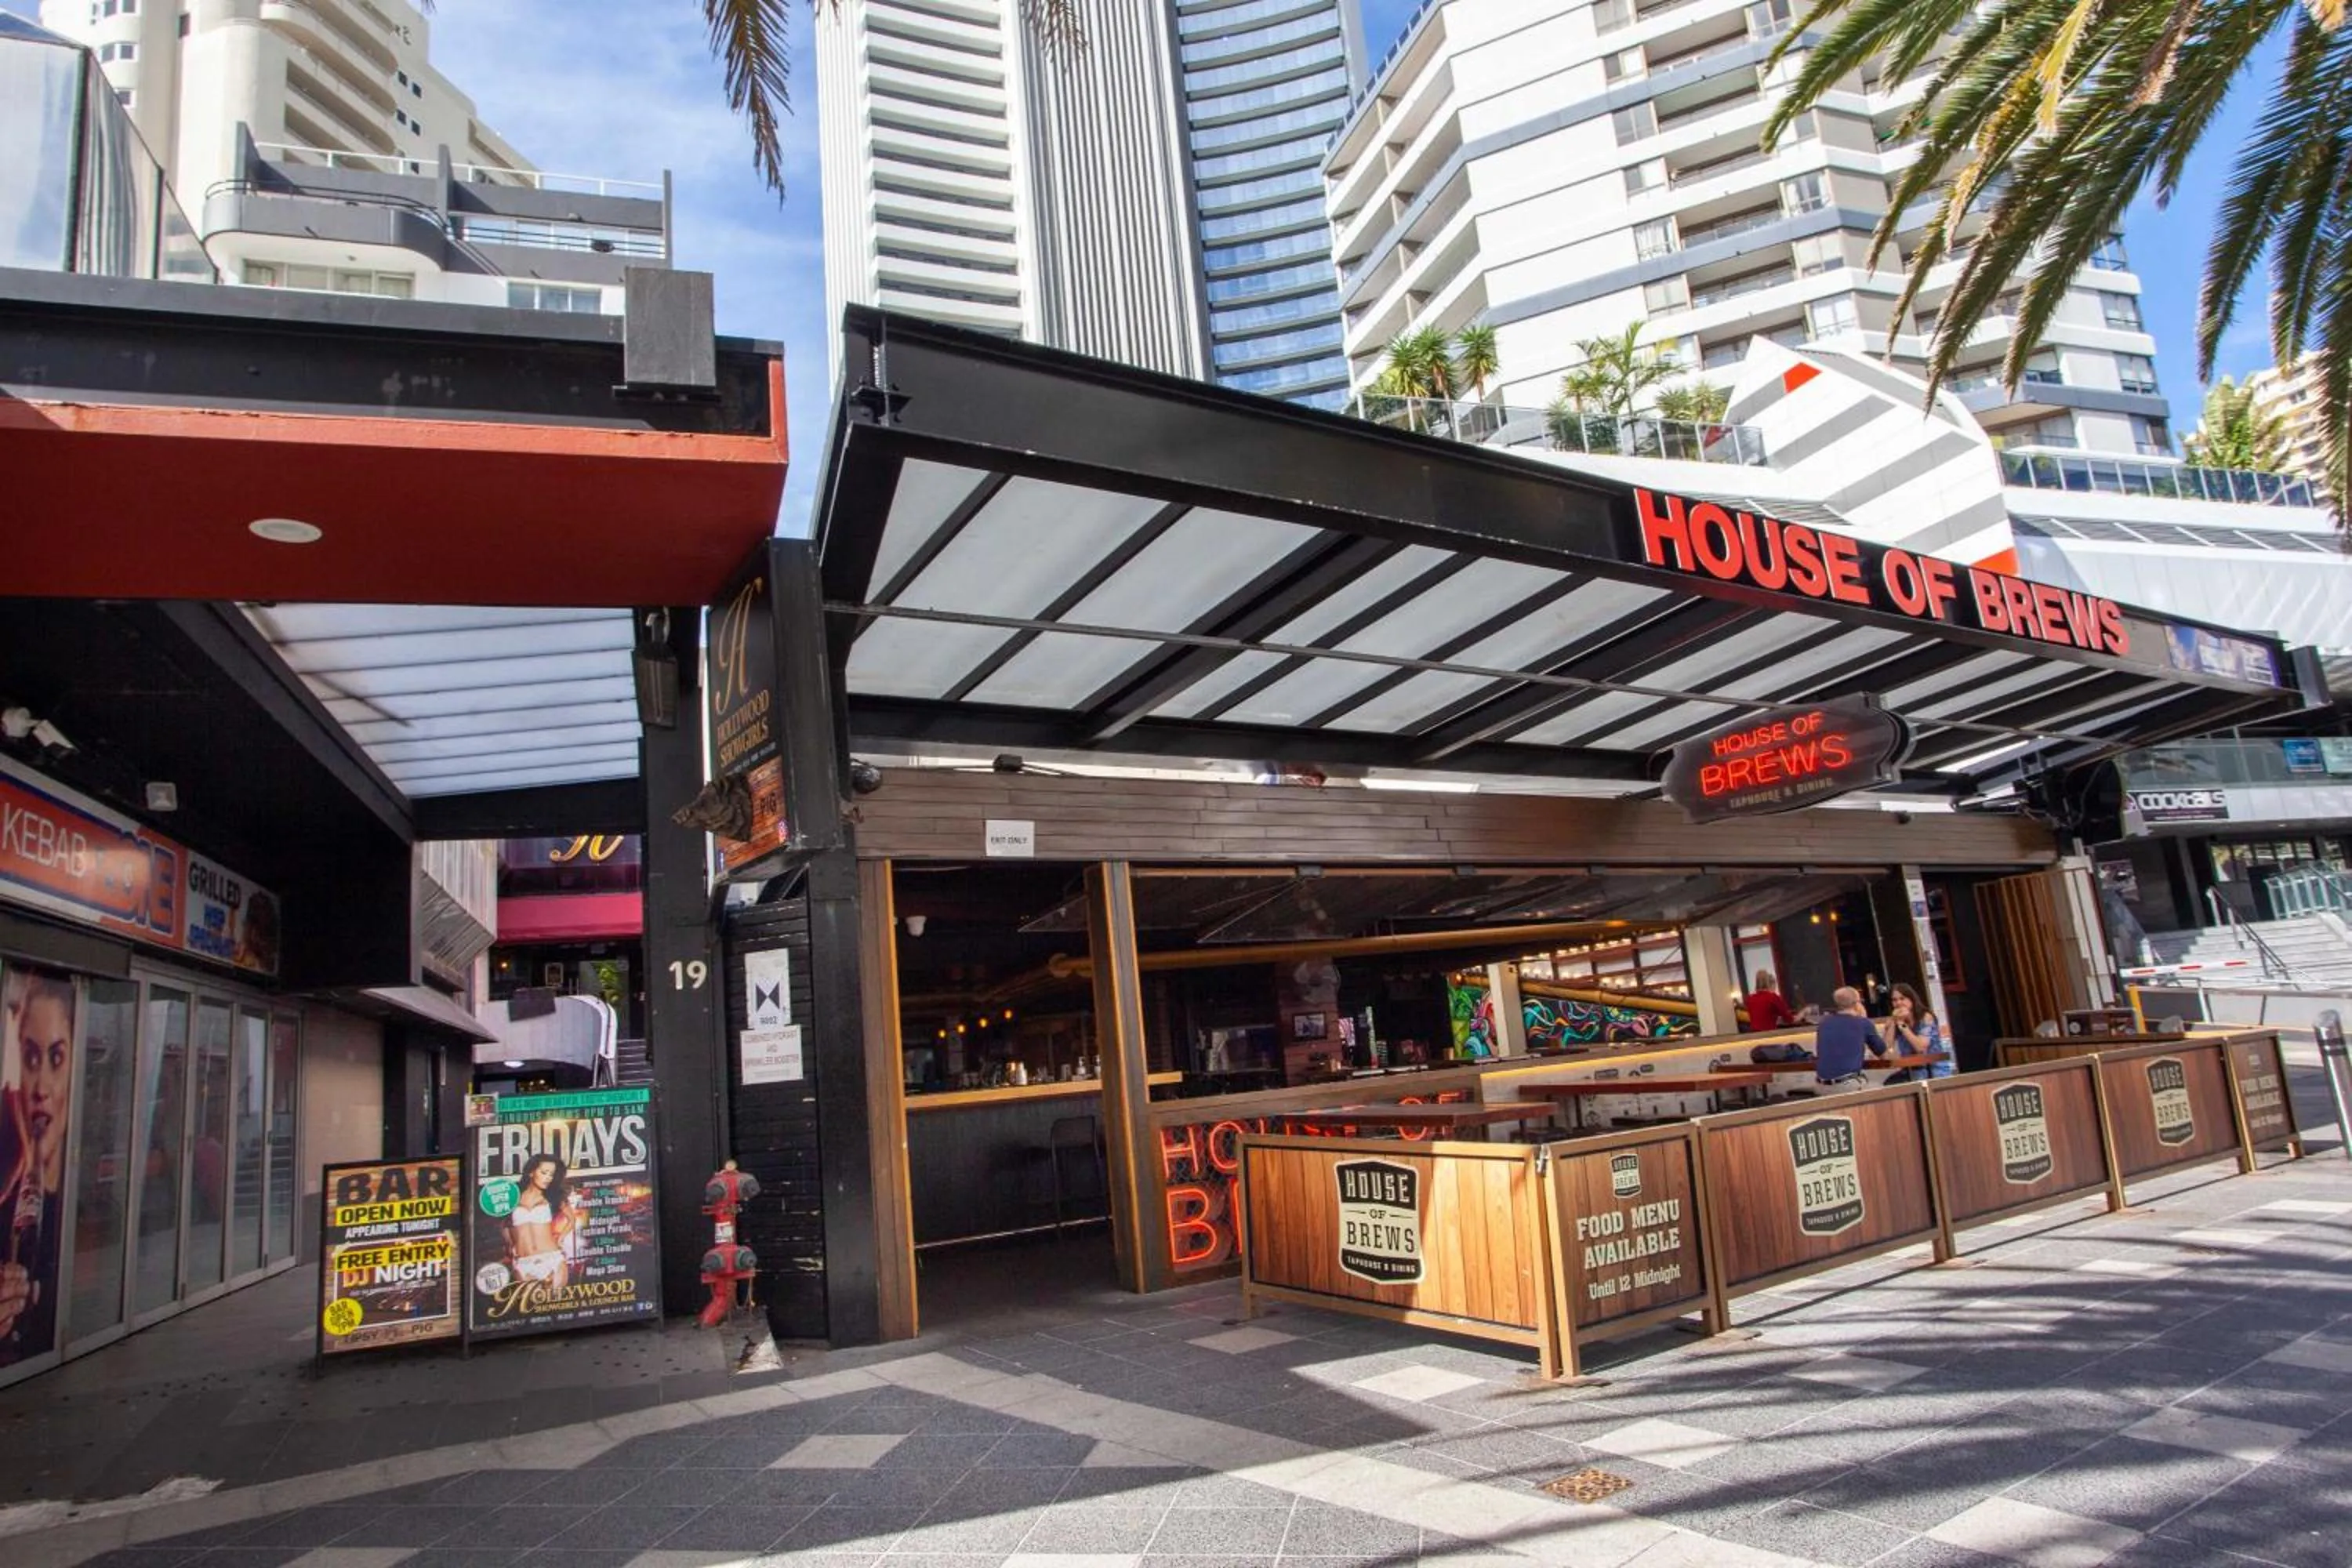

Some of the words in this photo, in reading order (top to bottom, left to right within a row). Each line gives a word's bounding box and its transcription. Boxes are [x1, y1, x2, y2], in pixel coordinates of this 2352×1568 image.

[1634, 487, 1871, 604] HOUSE
[1883, 548, 1957, 619] OF
[1969, 567, 2130, 656] BREWS
[1712, 723, 1787, 757] HOUSE
[1791, 711, 1824, 735] OF
[1700, 735, 1853, 796] BREWS
[2, 803, 87, 877] KEBAB
[188, 863, 241, 909] GRILLED
[669, 960, 707, 990] 19
[1999, 1091, 2039, 1119] HOUSE
[477, 1115, 647, 1177] FRIDAYS
[1796, 1126, 1849, 1160] HOUSE
[2005, 1132, 2046, 1159] BREWS
[1819, 1163, 1833, 1174] OF
[336, 1167, 450, 1205] BAR
[1345, 1169, 1410, 1203] HOUSE
[1803, 1174, 1857, 1207] BREWS
[340, 1205, 392, 1223] OPEN
[401, 1200, 447, 1218] NOW
[1369, 1209, 1386, 1219] OF
[1576, 1211, 1624, 1240] FOOD
[1630, 1199, 1680, 1229] MENU
[345, 1222, 398, 1238] APPEARING
[1346, 1221, 1415, 1253] BREWS
[336, 1251, 383, 1269] FREE
[389, 1243, 449, 1263] ENTRY
[1347, 1254, 1381, 1270] TAPHOUSE
[1392, 1263, 1416, 1274] DINING
[1584, 1227, 1681, 1270] AVAILABLE
[342, 1268, 370, 1287] DJ
[375, 1261, 445, 1283] NIGHT
[1588, 1279, 1616, 1300] Until
[1619, 1275, 1632, 1292] 12
[1635, 1264, 1681, 1288] Midnight
[487, 1279, 635, 1318] HOLLYWOOD
[412, 1323, 434, 1334] PIG
